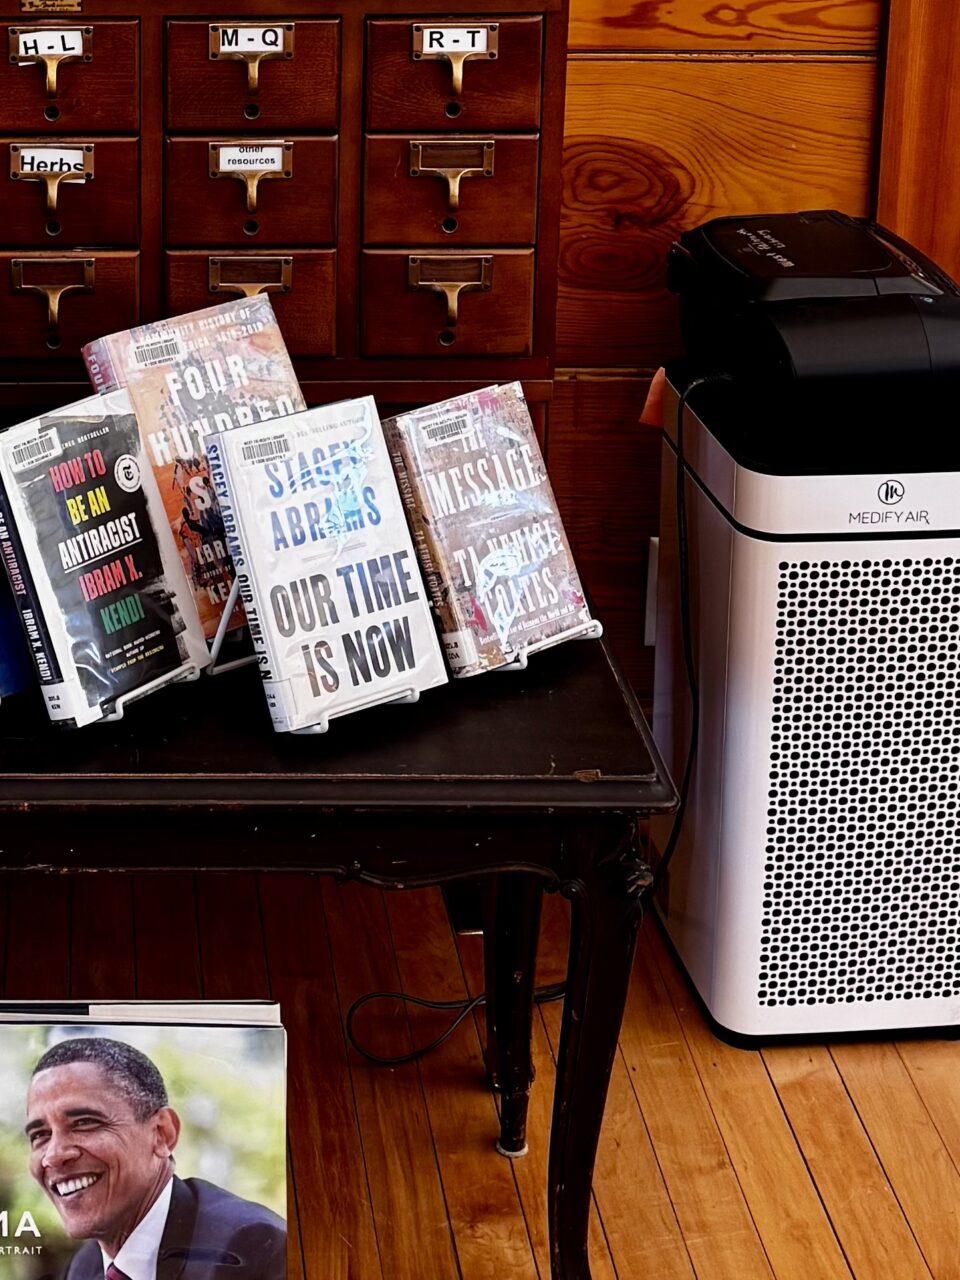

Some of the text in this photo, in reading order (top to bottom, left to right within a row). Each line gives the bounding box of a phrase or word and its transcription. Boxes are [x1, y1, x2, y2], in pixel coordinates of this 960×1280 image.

[23, 35, 76, 55] H L
[221, 28, 280, 48] M Q
[429, 30, 481, 48] R T
[20, 156, 84, 173] Herbs
[227, 157, 276, 166] resources
[165, 355, 249, 407] FOUR
[49, 456, 86, 493] HOW
[83, 448, 107, 479] TO
[427, 443, 542, 520] MESSAGE
[66, 485, 111, 526] BE AN
[848, 510, 930, 525] MEDIFY AIR
[58, 512, 141, 570] ANTIRACIST
[206, 443, 269, 668] STACEY ABRAMS OUR TIME IS
[1, 539, 27, 596] ANTIRACIST
[79, 555, 144, 602] IBRAM X.
[100, 593, 146, 634] KENDI
[270, 549, 420, 639] OUR TIME
[22, 608, 53, 682] IBRAM X. KENDI
[300, 640, 341, 699] IS
[340, 615, 418, 688] NOW
